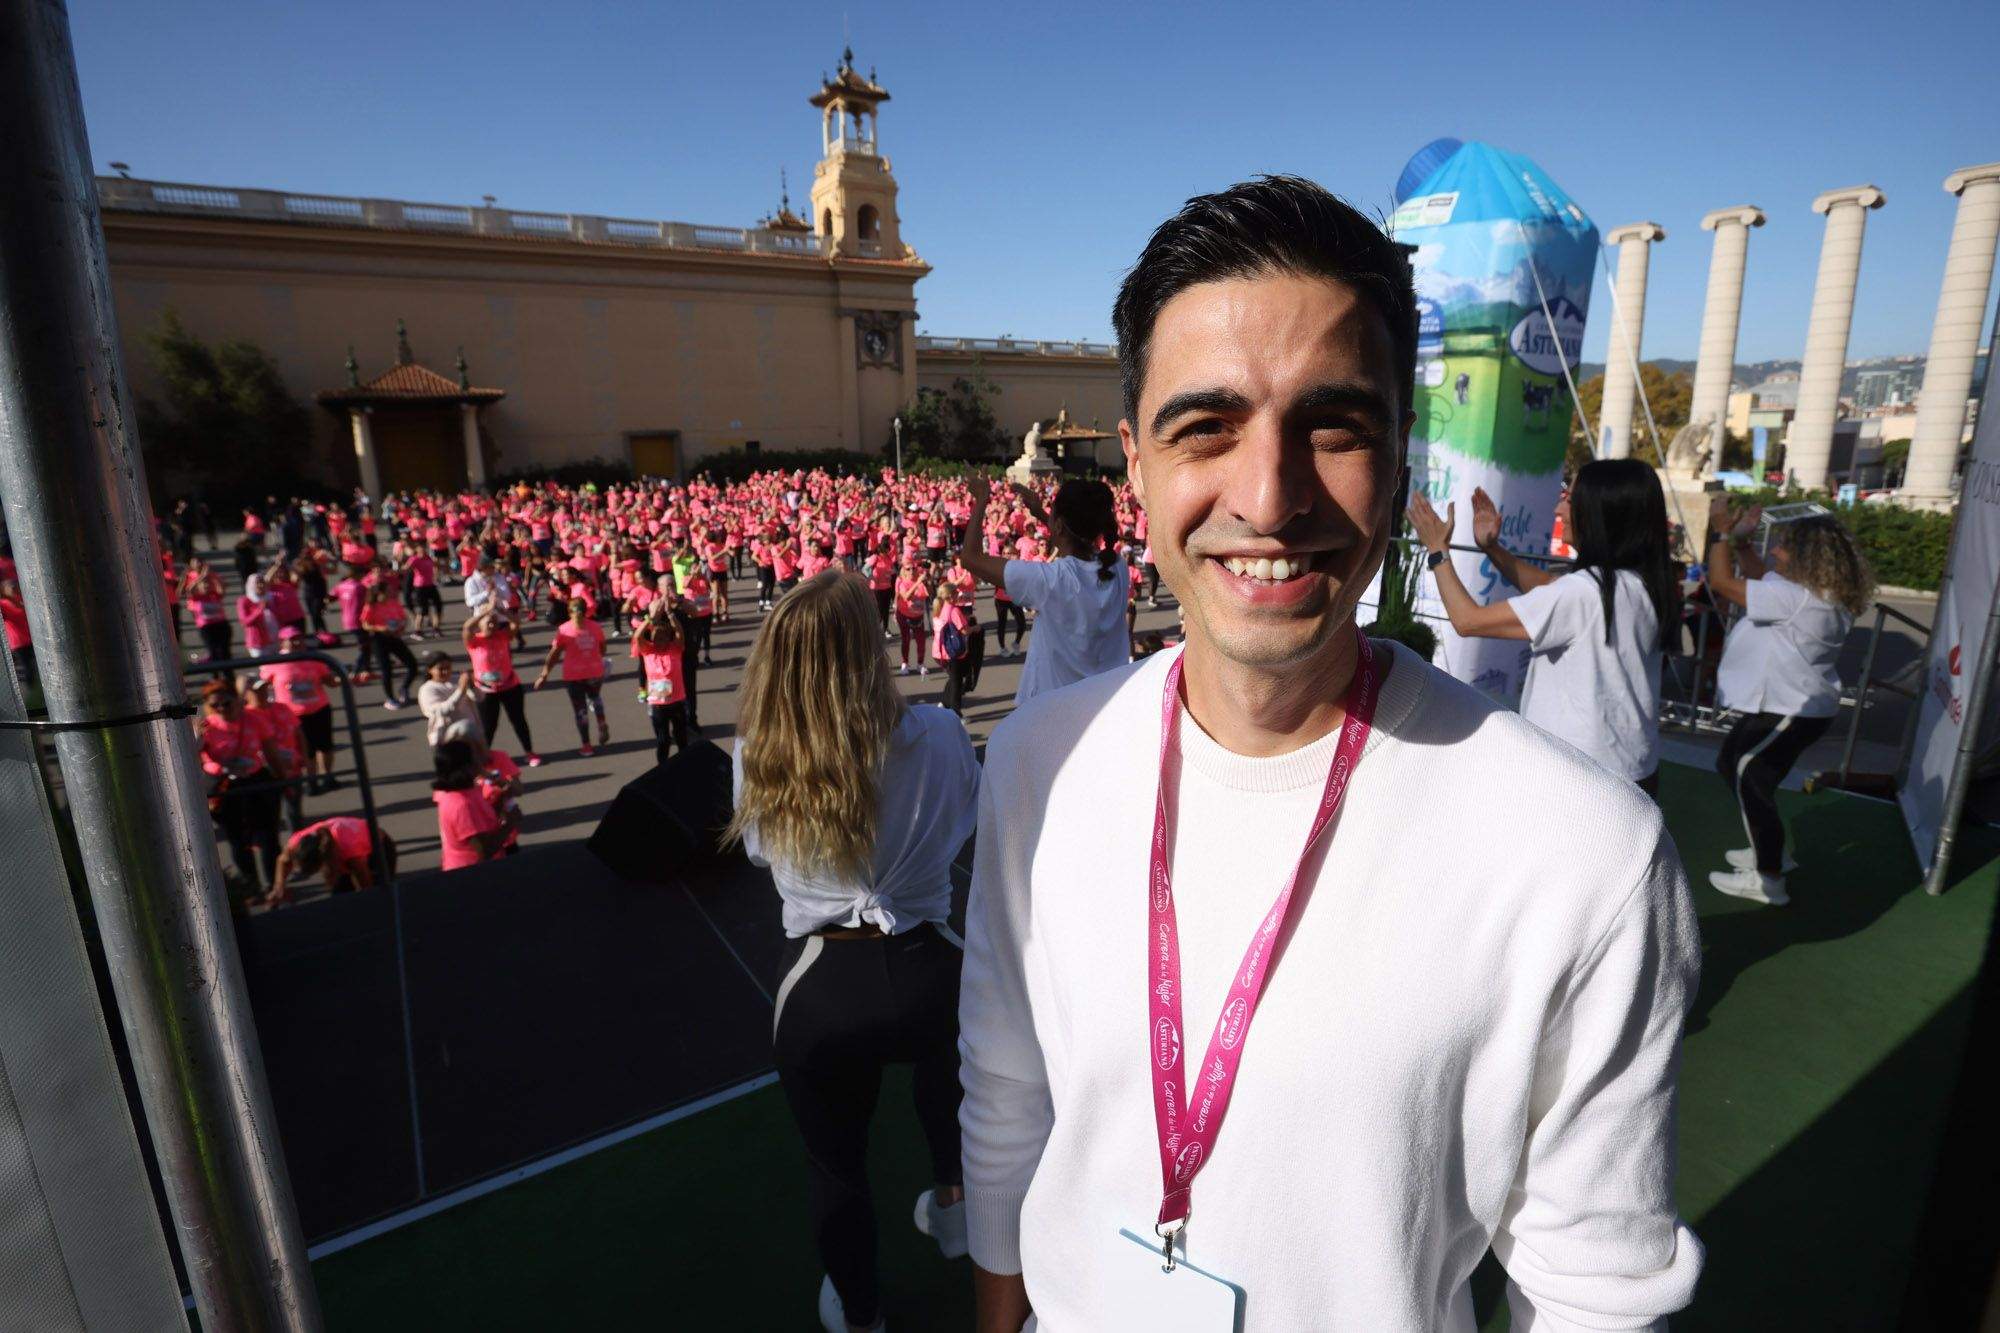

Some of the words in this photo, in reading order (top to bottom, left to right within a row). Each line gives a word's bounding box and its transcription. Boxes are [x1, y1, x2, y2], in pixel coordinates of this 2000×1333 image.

[1347, 717, 1363, 748] Mujer
[1327, 759, 1346, 803] ASTURIANA
[1160, 924, 1170, 960] Carrera
[1241, 950, 1261, 988] Carrera
[1156, 976, 1174, 1007] Mujer
[1160, 1021, 1170, 1067] ASTURIANA
[1224, 1002, 1245, 1048] ASTURIANA
[1164, 1081, 1177, 1118] Carrera
[1193, 1098, 1211, 1132] Carrera
[1207, 1056, 1226, 1087] Mujer
